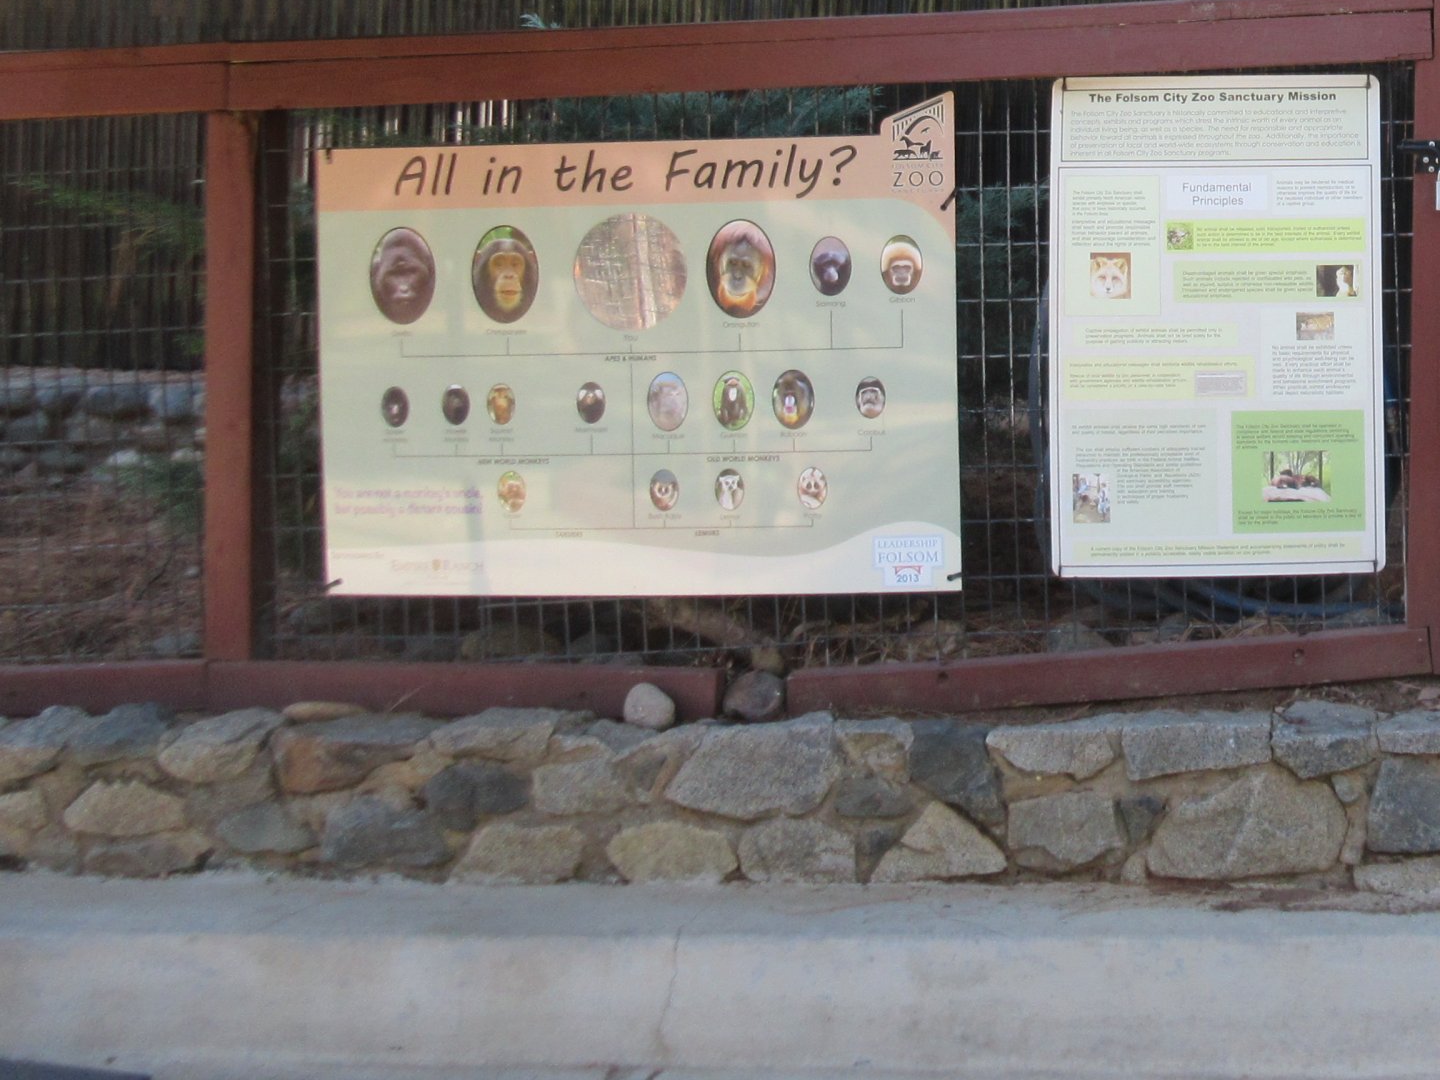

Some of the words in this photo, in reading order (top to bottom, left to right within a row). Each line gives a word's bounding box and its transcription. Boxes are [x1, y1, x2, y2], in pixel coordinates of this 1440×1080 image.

[1089, 92, 1111, 103] The
[1115, 92, 1159, 102] Folsom
[1163, 91, 1187, 104] City
[1191, 91, 1214, 102] Zoo
[1219, 90, 1283, 104] Sanctuary
[1288, 90, 1337, 101] Mission
[394, 152, 457, 196] All
[483, 155, 522, 194] in
[555, 150, 634, 191] the
[664, 143, 858, 201] Family?
[893, 171, 944, 187] ZOO
[1182, 181, 1252, 192] Fundamental
[1192, 195, 1244, 208] Principles
[878, 539, 938, 548] LEADERSHIP
[878, 551, 939, 563] FOLSOM
[896, 575, 919, 583] 2013
